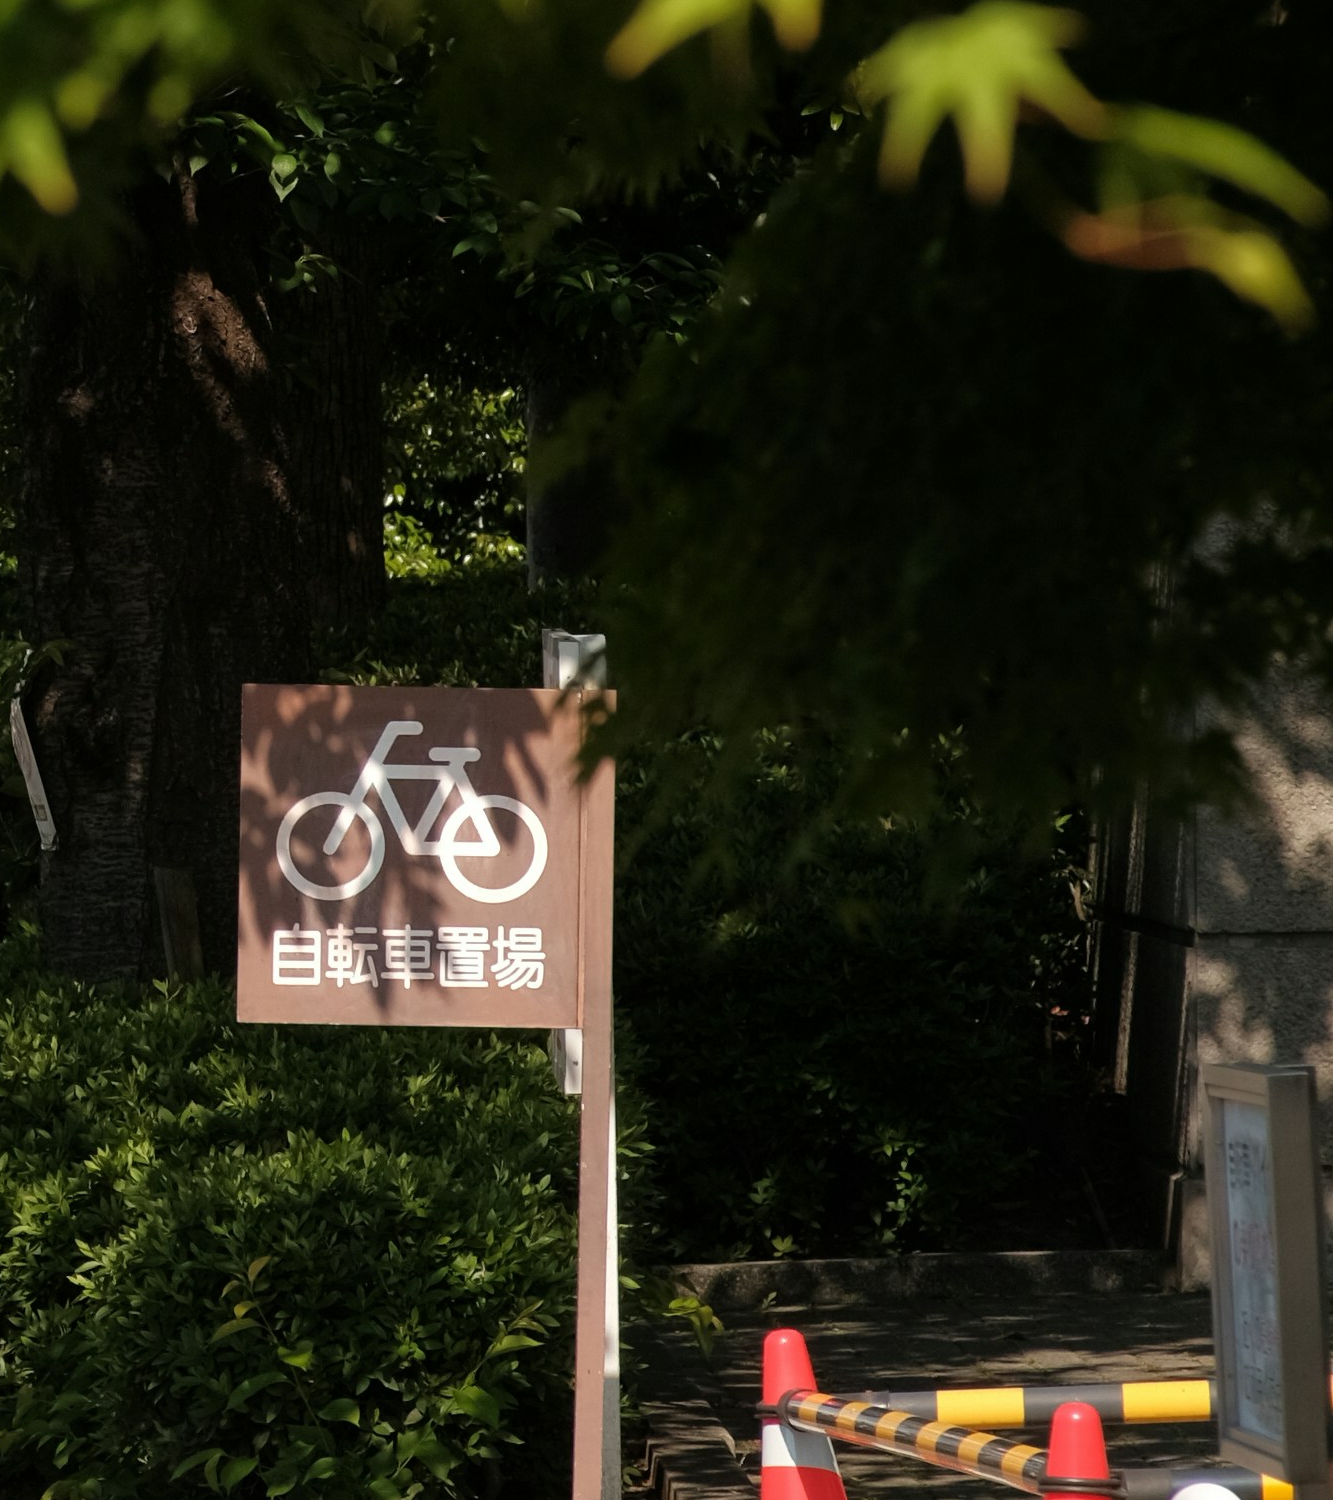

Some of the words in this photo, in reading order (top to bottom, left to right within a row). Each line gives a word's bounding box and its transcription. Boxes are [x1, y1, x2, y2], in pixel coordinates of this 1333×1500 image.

[272, 923, 546, 990] 自転車置場
